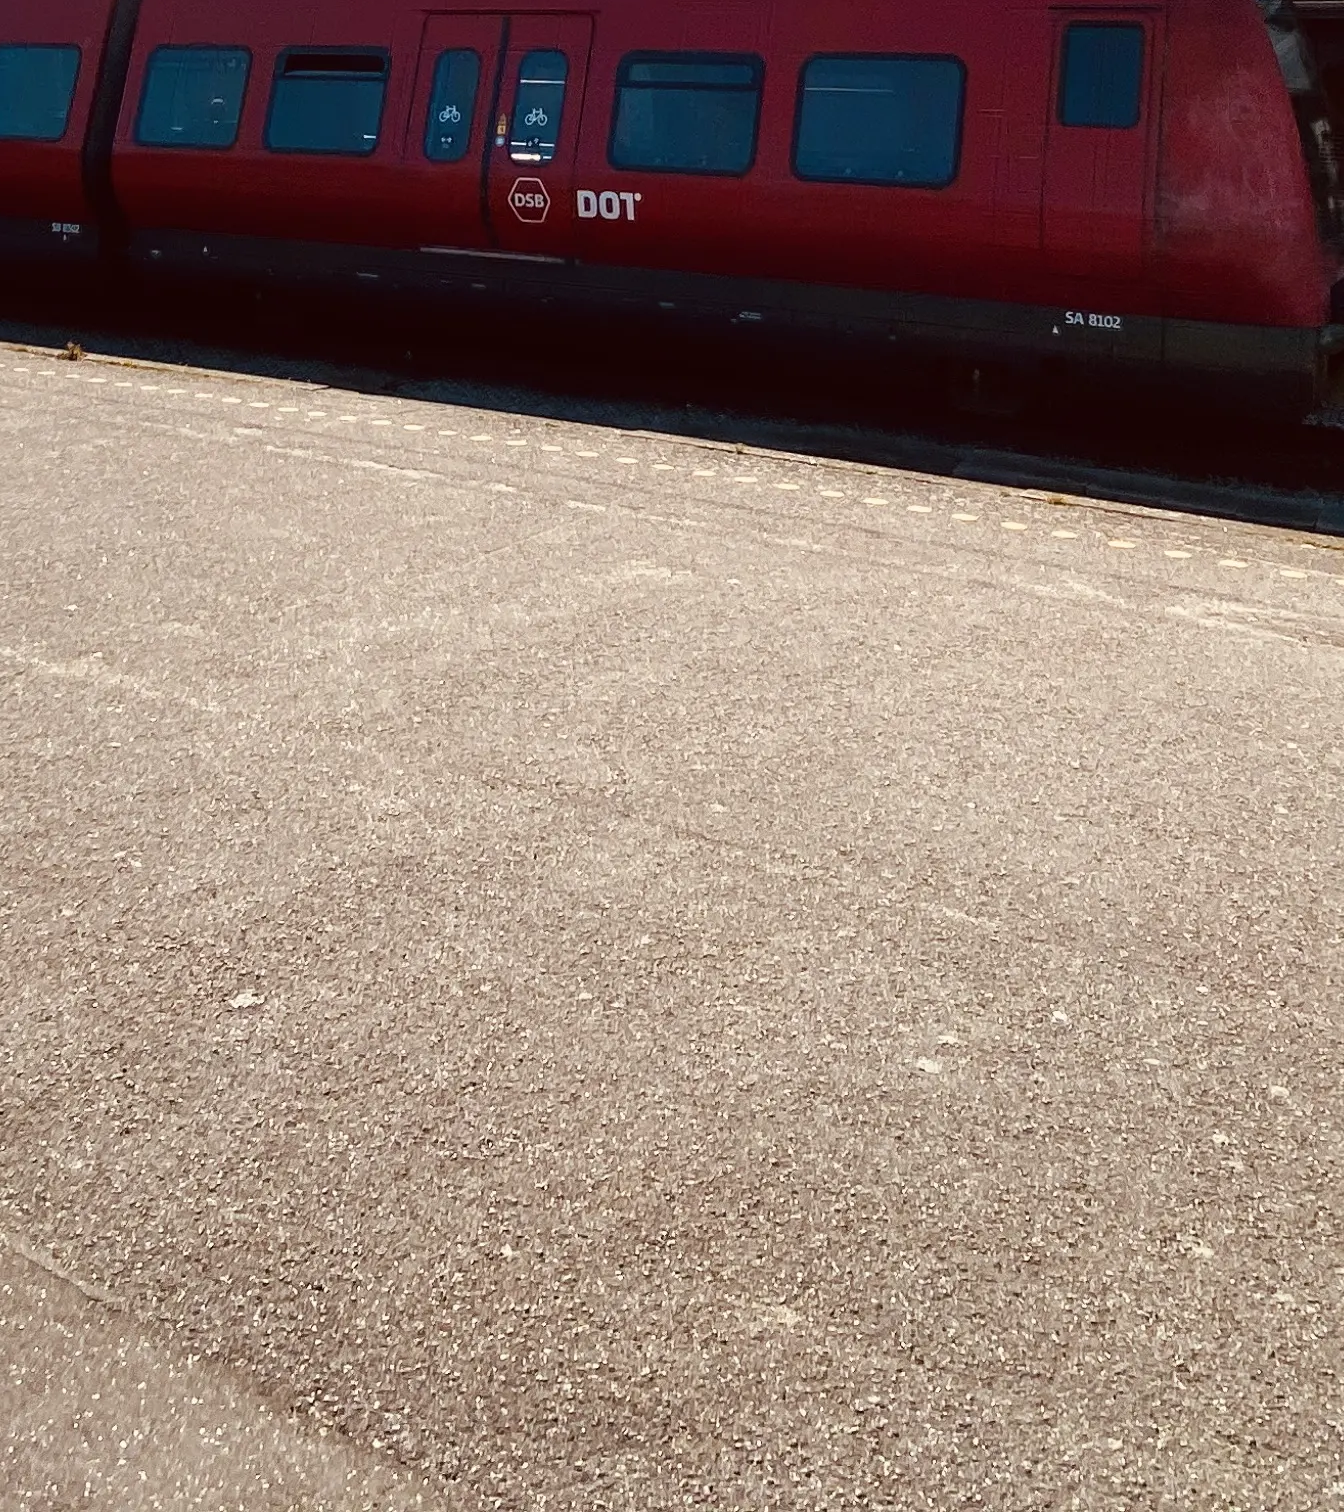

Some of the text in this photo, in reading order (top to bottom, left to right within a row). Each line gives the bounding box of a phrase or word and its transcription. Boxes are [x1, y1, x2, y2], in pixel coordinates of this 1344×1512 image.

[514, 193, 544, 208] DSB
[577, 190, 642, 221] DOT
[1065, 311, 1122, 329] SA 8102
